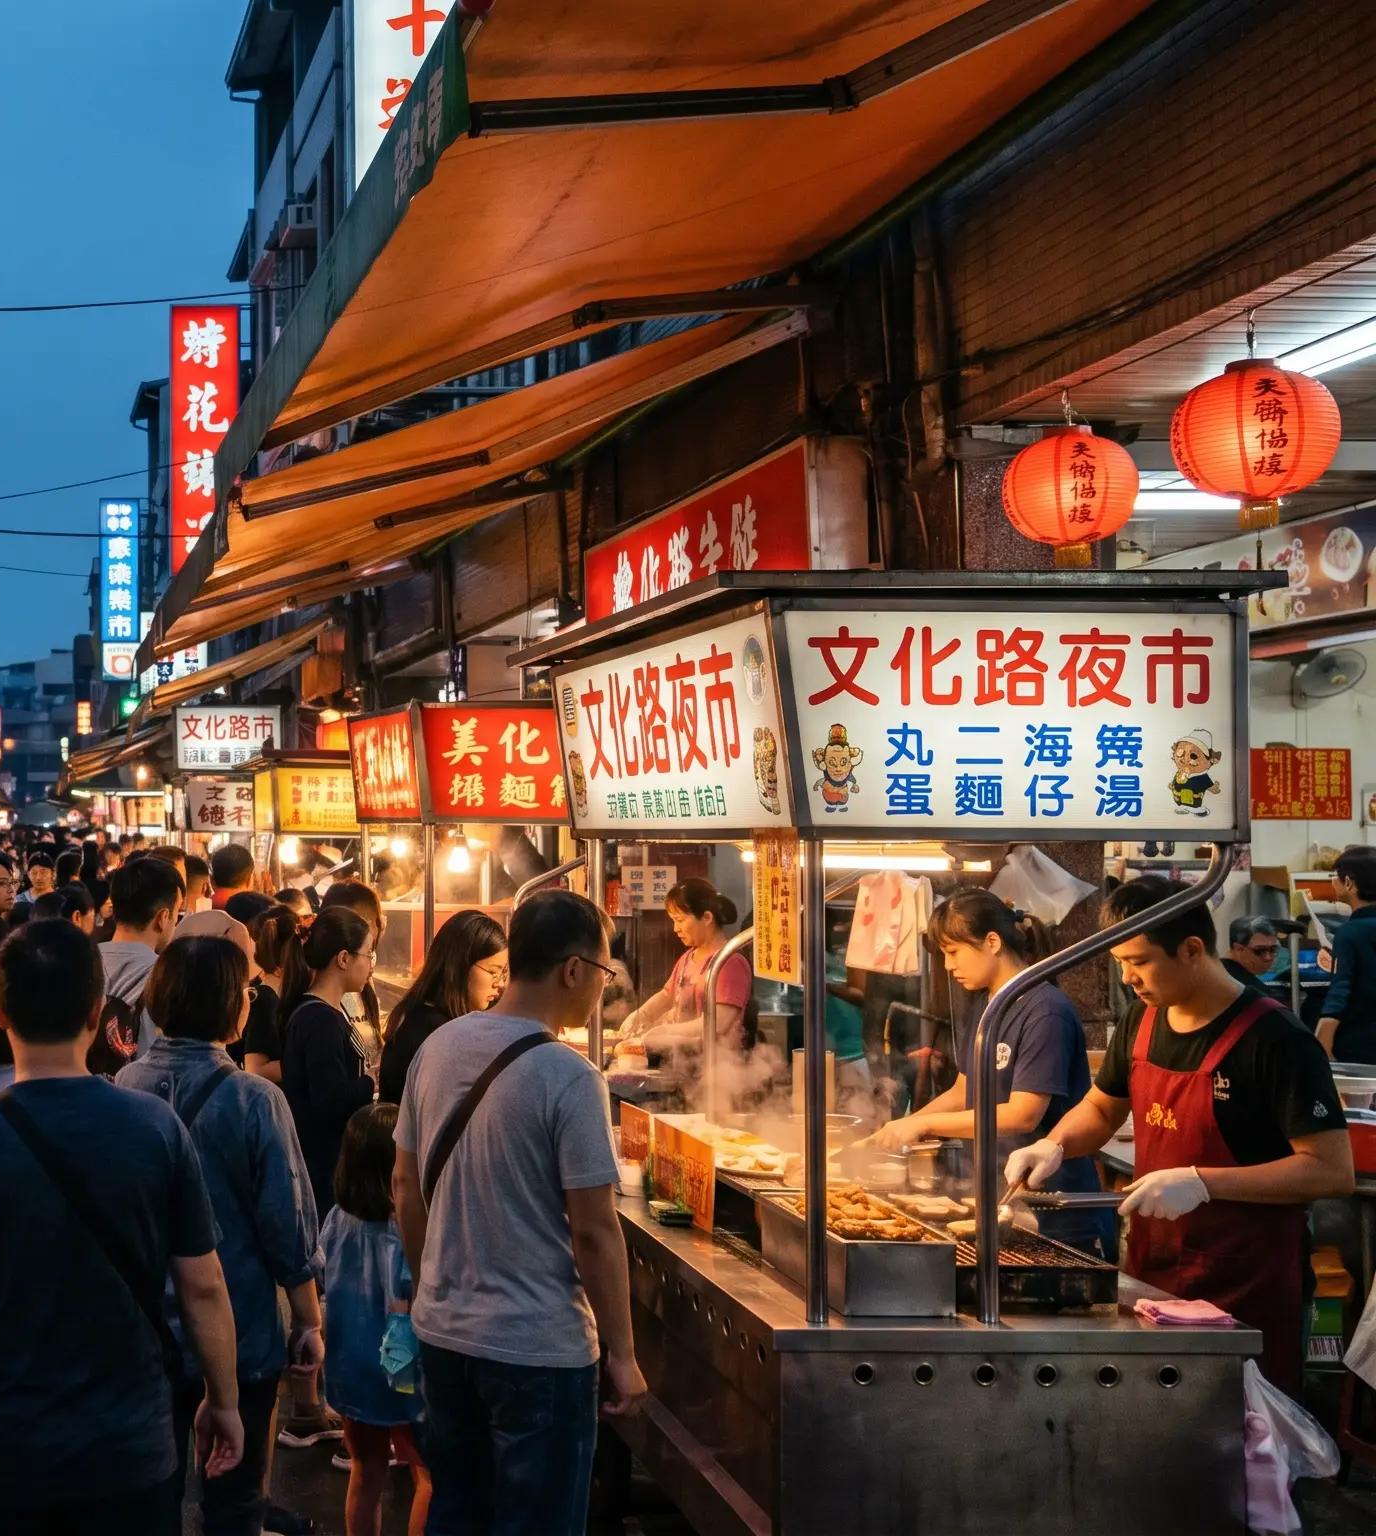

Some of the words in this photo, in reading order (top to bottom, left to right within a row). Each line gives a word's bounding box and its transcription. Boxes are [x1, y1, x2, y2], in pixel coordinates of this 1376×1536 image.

[807, 625, 1214, 709] 文化路夜市
[182, 714, 274, 741] 文化路市
[580, 643, 741, 781] 文化路夜市
